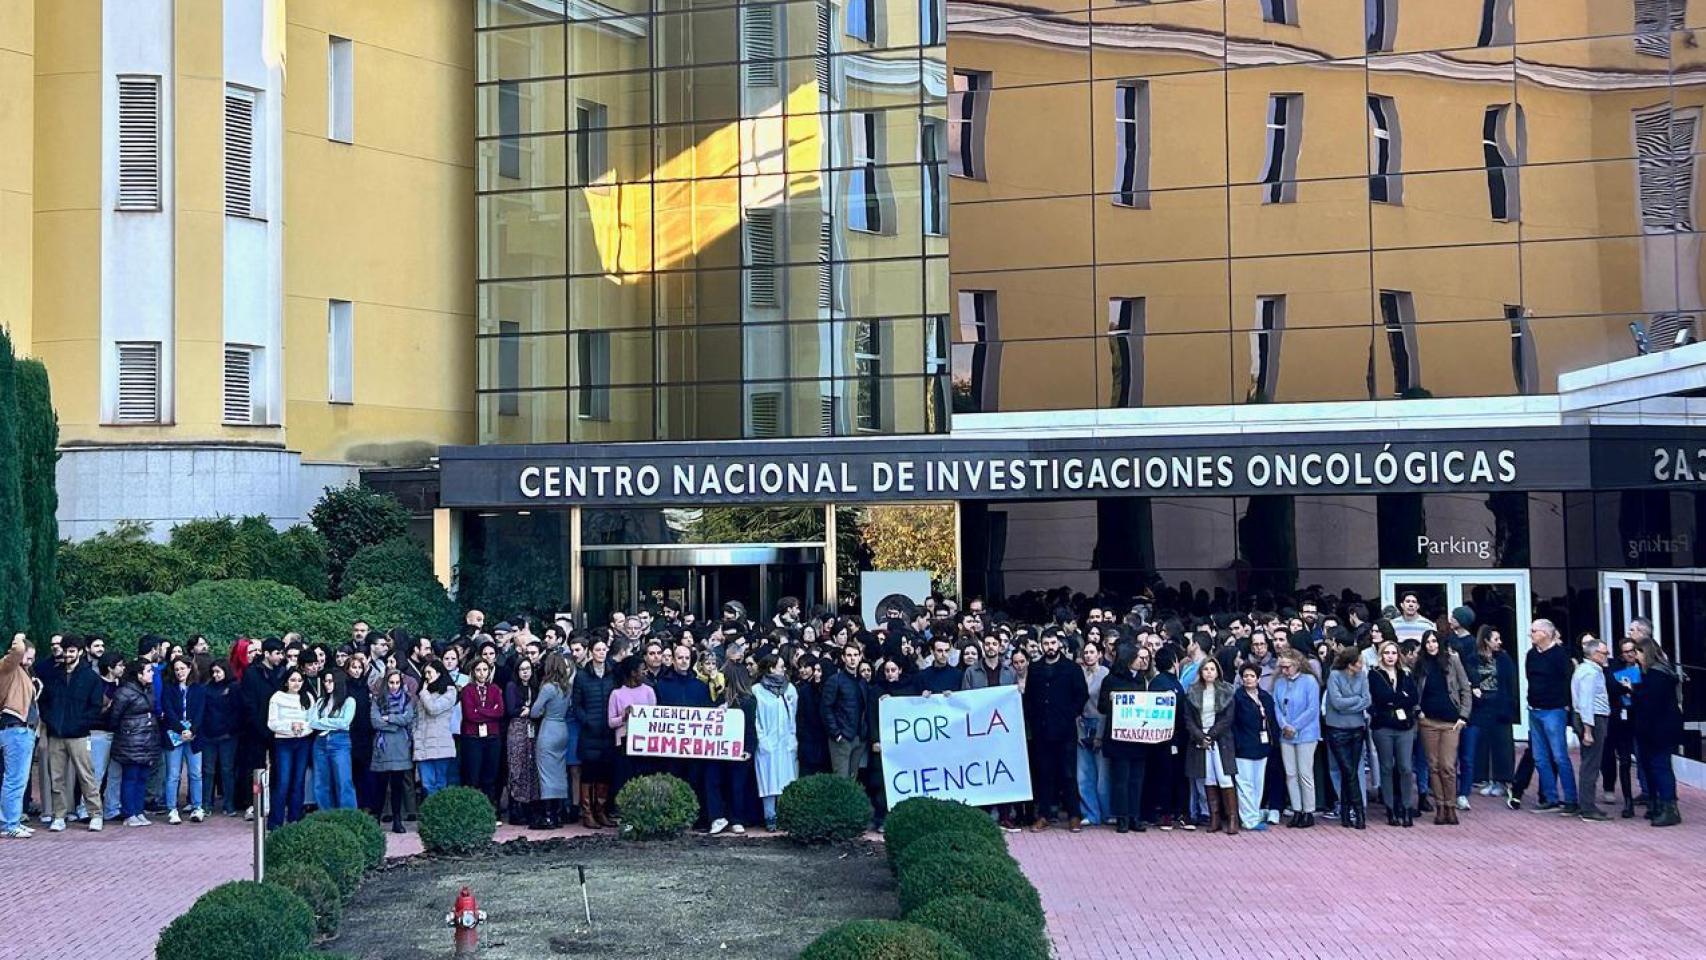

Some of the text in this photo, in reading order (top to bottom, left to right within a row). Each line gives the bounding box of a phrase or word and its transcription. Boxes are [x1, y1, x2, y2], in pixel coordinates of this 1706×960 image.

[519, 444, 1516, 496] CENTRO NACIONAL DE INVESTIGACIONES ONCOLÓGICAS
[1417, 535, 1490, 559] Parking
[631, 707, 724, 722] LA CIENCIA ES
[1116, 694, 1135, 705] POR
[893, 708, 1010, 745] POR LA
[893, 759, 1015, 795] CIENCIA
